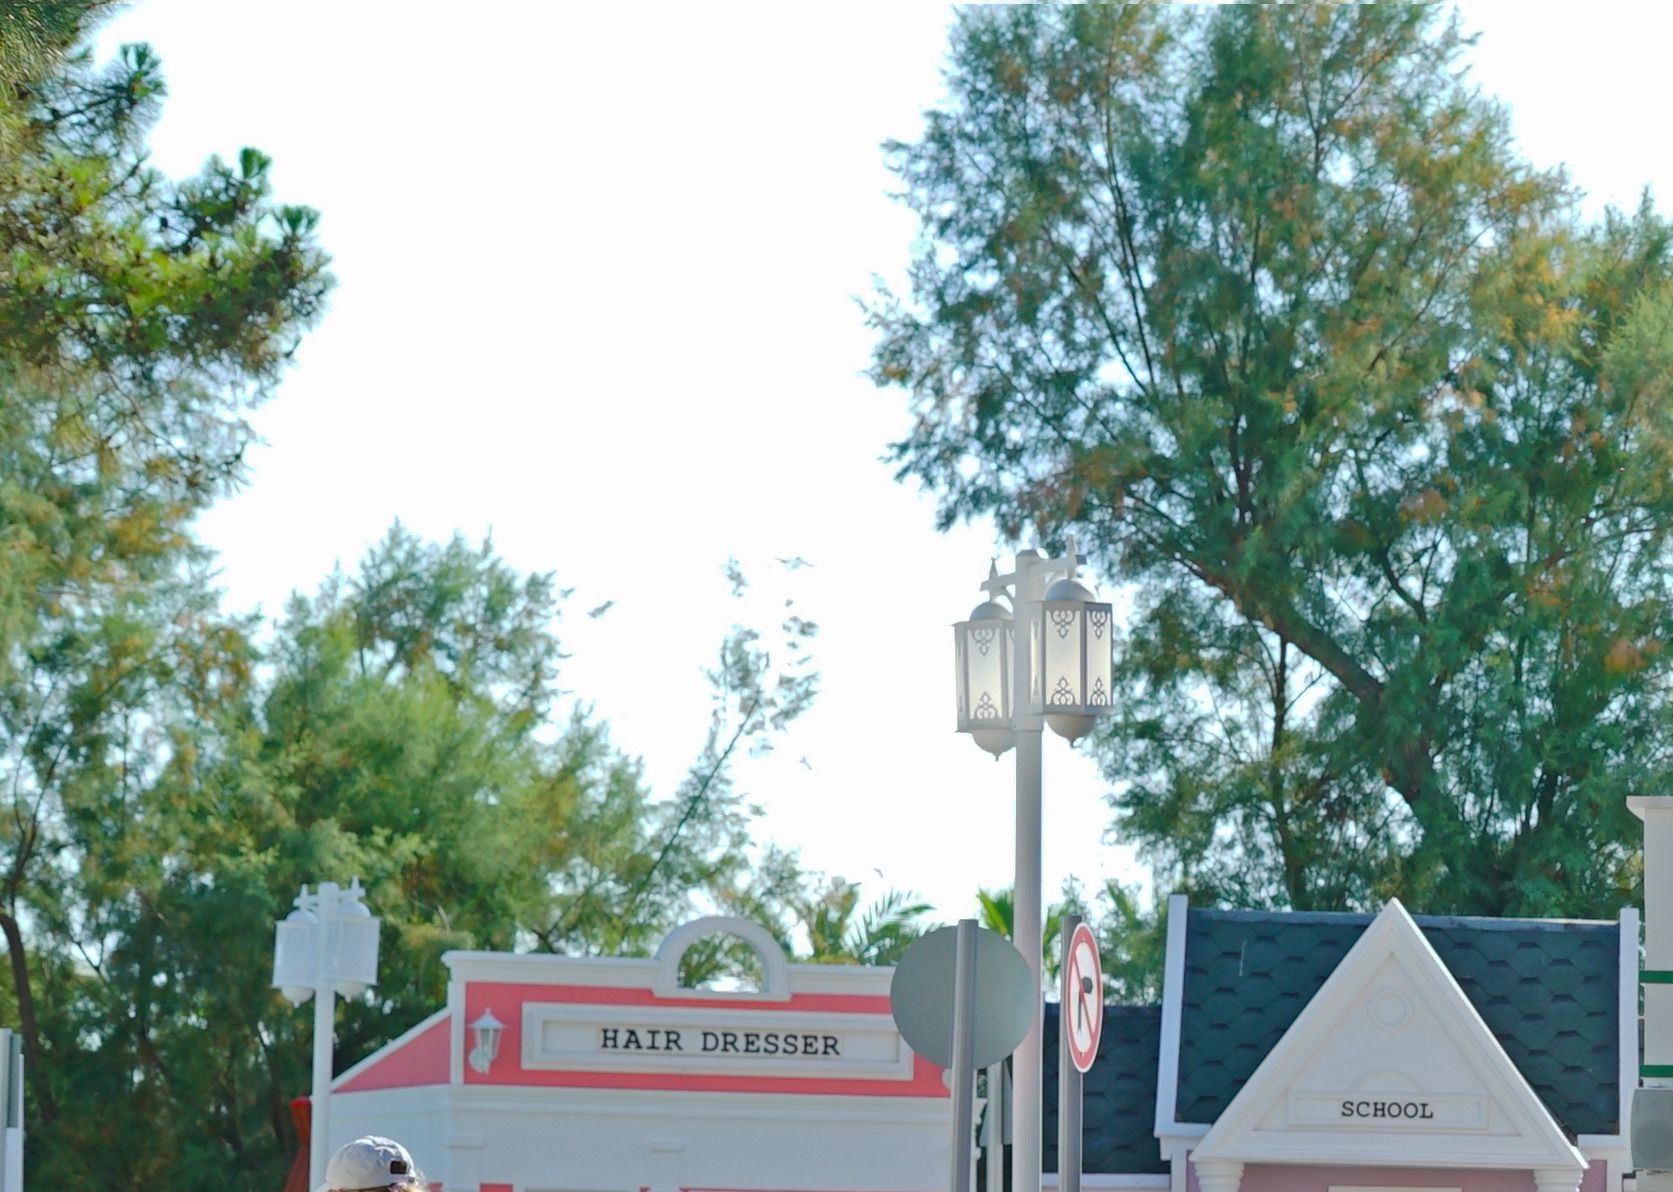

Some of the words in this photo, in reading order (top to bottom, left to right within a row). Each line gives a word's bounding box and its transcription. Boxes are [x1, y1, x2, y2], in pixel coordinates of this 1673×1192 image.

[601, 1028, 684, 1051] HAIR
[701, 1031, 841, 1056] DRESSER
[1341, 1101, 1434, 1119] SCHOOL
